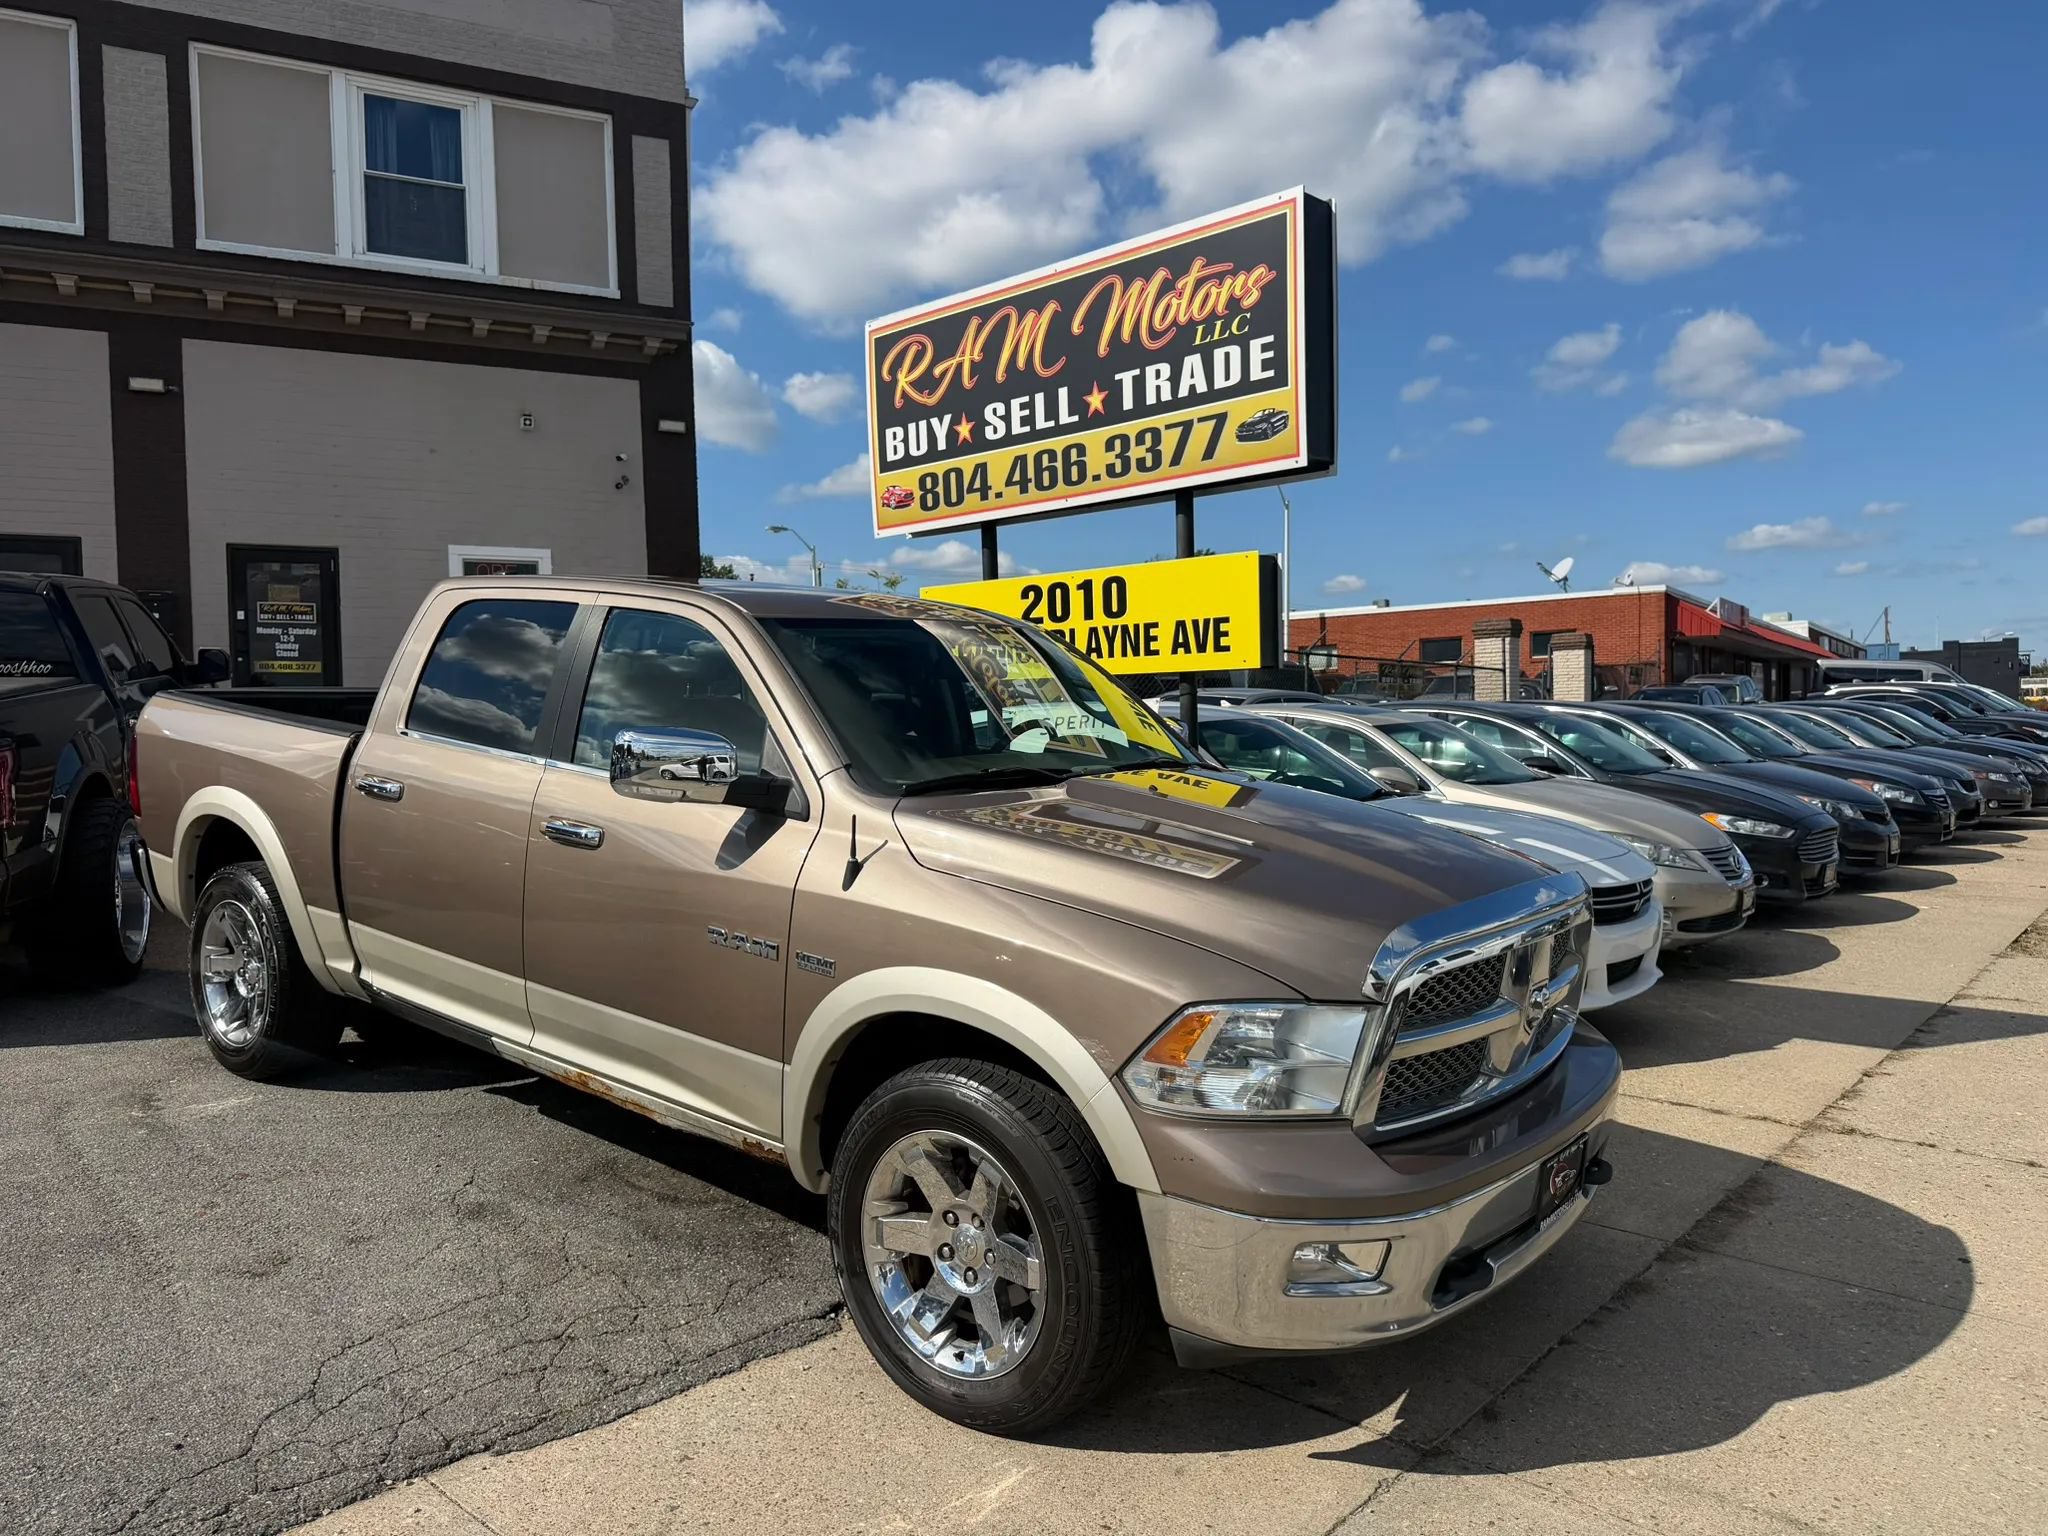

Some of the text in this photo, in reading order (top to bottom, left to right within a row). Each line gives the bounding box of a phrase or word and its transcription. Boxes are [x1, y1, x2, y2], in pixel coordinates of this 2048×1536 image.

[881, 256, 1277, 408] RAM Motors
[1192, 312, 1252, 346] LLC
[885, 334, 1275, 462] BUY SELL TRADE
[917, 411, 1229, 512] 804.466.3377
[1020, 575, 1128, 624] 2010
[256, 626, 282, 635] Monday
[288, 627, 317, 636] Saturday
[275, 642, 299, 650] Sunday
[1171, 616, 1231, 655] AVE
[276, 649, 299, 657] Closed
[707, 925, 780, 962] RAM
[796, 950, 836, 970] HEMI
